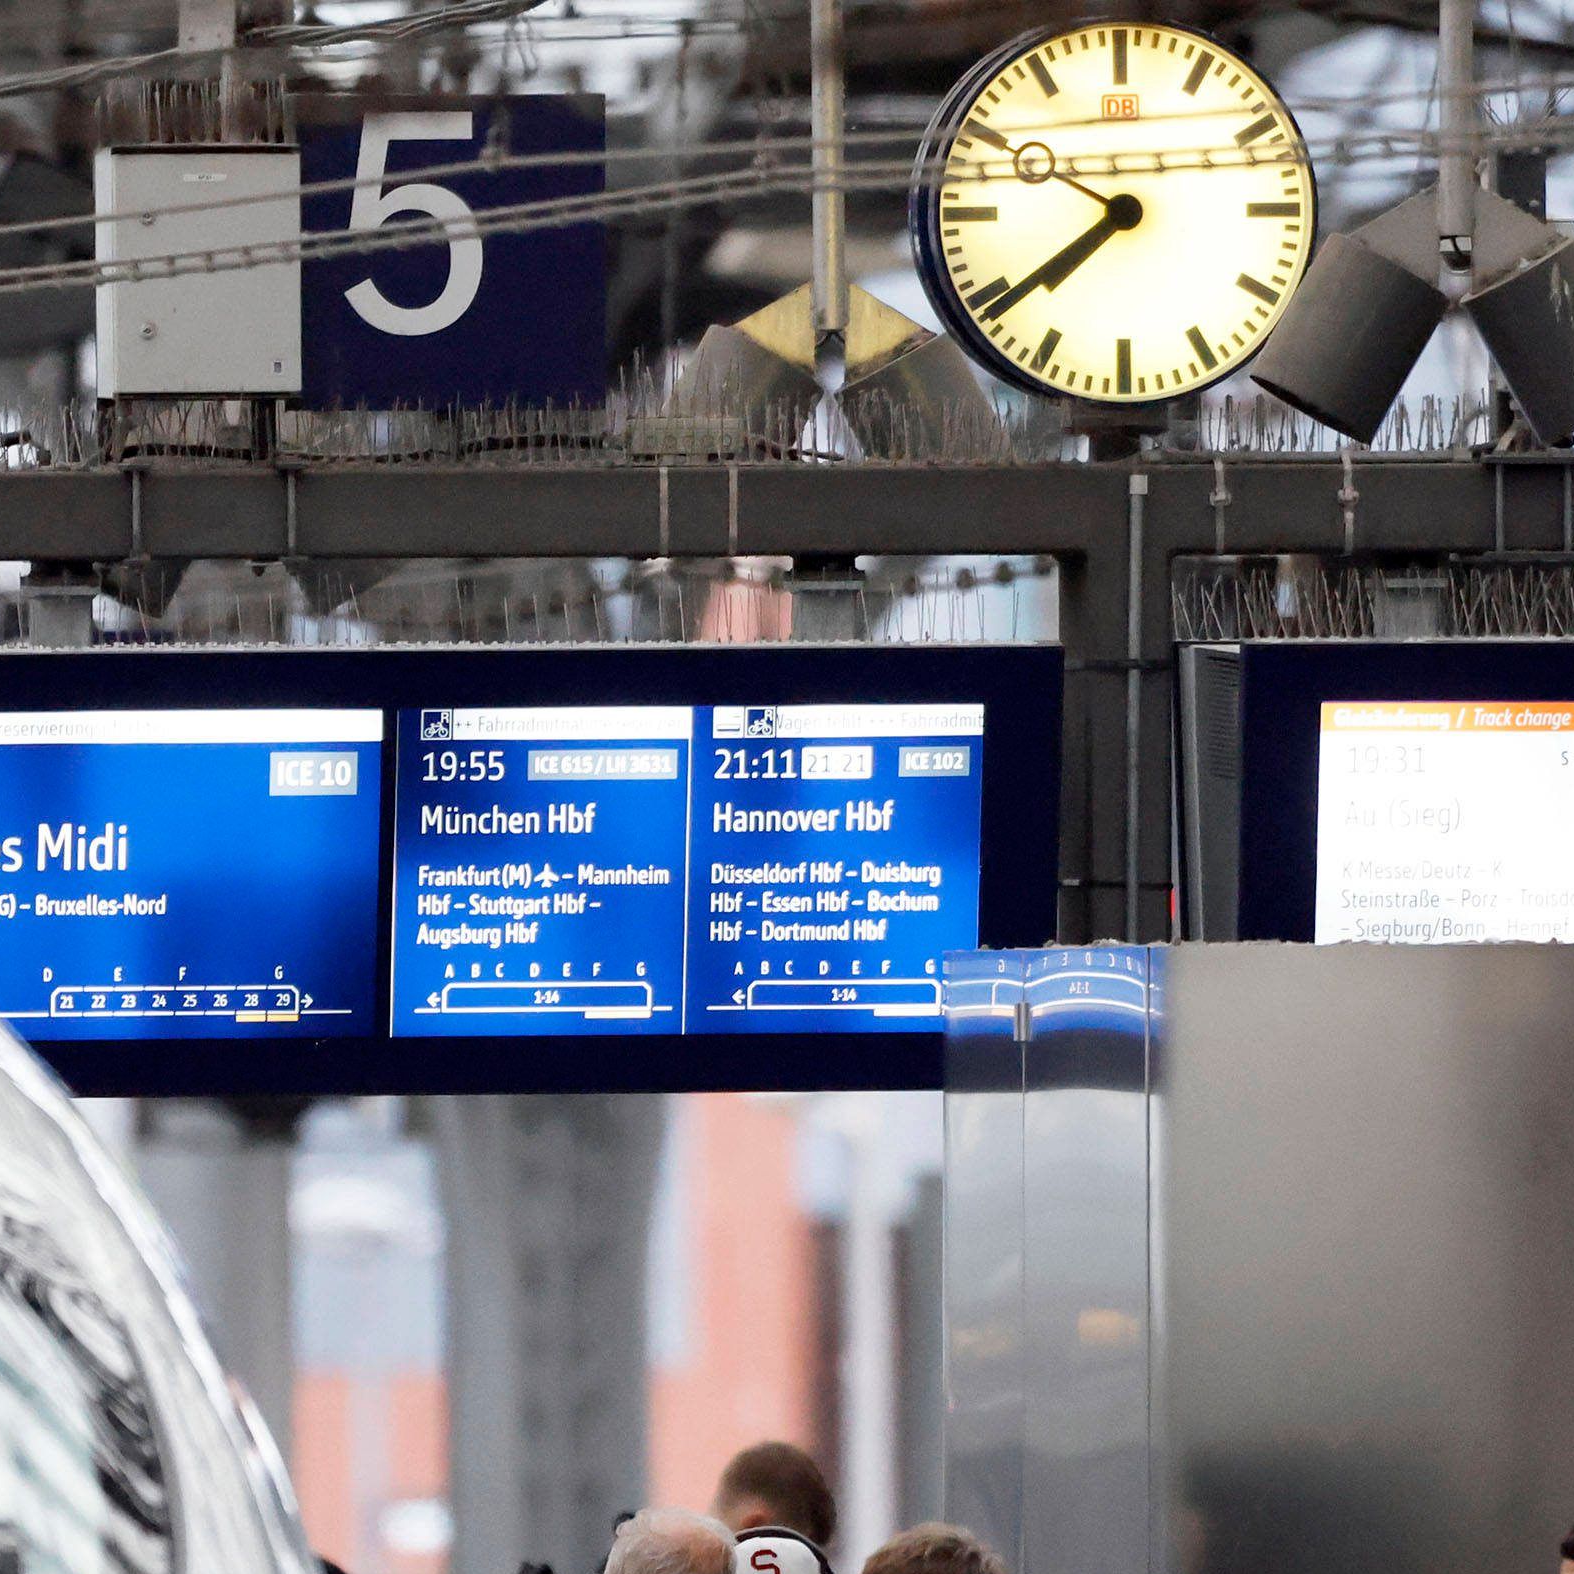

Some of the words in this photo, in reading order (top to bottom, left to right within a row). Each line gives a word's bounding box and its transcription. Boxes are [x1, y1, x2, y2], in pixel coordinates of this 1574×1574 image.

[1106, 98, 1135, 118] DB
[344, 110, 484, 337] 5
[1474, 708, 1511, 726] Track
[1515, 708, 1572, 731] change
[423, 751, 504, 781] 19:55
[534, 757, 559, 774] ICE
[714, 749, 797, 778] 21:11
[905, 752, 929, 771] ICE
[933, 752, 964, 770] 102
[1347, 745, 1426, 774] 19:31
[1560, 750, 1569, 765] S
[277, 760, 314, 787] ICE
[320, 760, 352, 787] 10
[422, 805, 540, 834] München
[549, 803, 596, 833] Hbf
[714, 803, 840, 832] Hannover
[846, 800, 893, 831] Hbf
[38, 823, 127, 871] Midi
[578, 864, 669, 884] Mannheim
[711, 862, 806, 883] Düsseldorf
[810, 862, 843, 883] Hbf
[862, 861, 941, 887] Duisburg
[1359, 860, 1471, 881] Messe/Deutz
[36, 894, 166, 915] Bruxelles-Nord
[418, 894, 450, 915] Hbf
[469, 894, 550, 920] Stuttgart
[554, 893, 586, 914] Hbf
[711, 892, 742, 912] Hbf
[762, 891, 812, 912] Essen
[817, 890, 849, 911] Hbf
[868, 890, 939, 911] Bochum
[1340, 889, 1440, 910] Steinstraße
[1461, 889, 1498, 908] Porz
[417, 923, 501, 949] Augsburg
[505, 922, 538, 943] Hbf
[710, 921, 742, 941] Hbf
[762, 920, 850, 941] Dortmund
[854, 919, 886, 941] Hbf
[1355, 917, 1486, 942] Siegburg/Bonn
[44, 968, 52, 982] D
[114, 967, 122, 981] E
[180, 967, 186, 980] F
[275, 966, 282, 979] G
[445, 964, 454, 978] A
[472, 964, 480, 978] B
[496, 963, 504, 977] C
[530, 963, 540, 977] D
[563, 963, 570, 977] E
[593, 963, 601, 976] F
[637, 962, 645, 976] G
[734, 962, 743, 974] A
[761, 961, 769, 974] B
[785, 961, 792, 975] C
[820, 961, 829, 975] D
[852, 961, 860, 974] E
[882, 960, 890, 974] F
[925, 959, 935, 974] G
[59, 992, 73, 1008] 21
[92, 995, 106, 1008] 22
[121, 994, 136, 1008] 23
[152, 994, 166, 1007] 24
[183, 995, 197, 1007] 25
[214, 994, 227, 1006] 26
[245, 994, 258, 1006] 28
[276, 994, 290, 1006] 29
[535, 990, 559, 1007] 1-14
[832, 988, 857, 1001] 1-14
